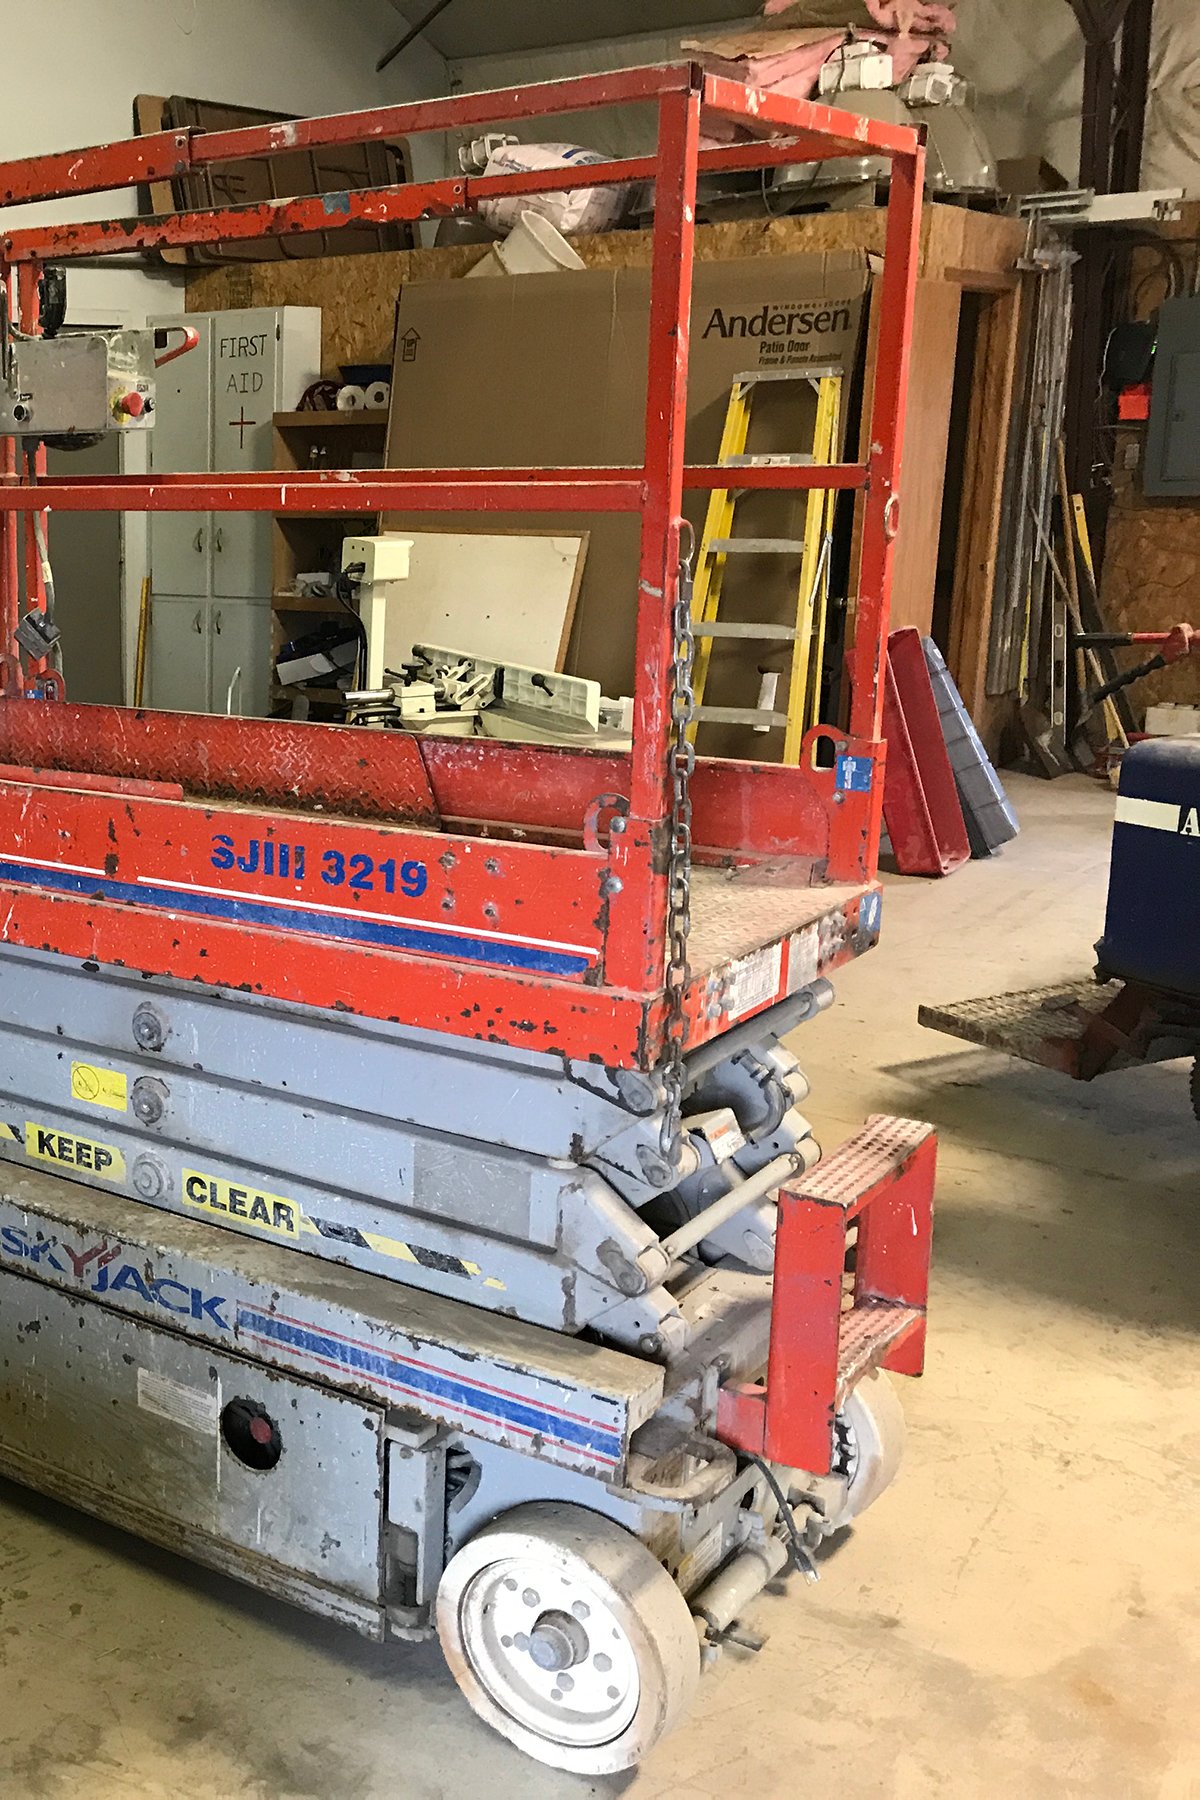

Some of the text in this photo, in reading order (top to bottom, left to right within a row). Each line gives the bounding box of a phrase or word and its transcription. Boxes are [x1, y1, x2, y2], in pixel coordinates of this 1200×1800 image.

[701, 305, 851, 339] Andersen
[220, 334, 267, 358] FIRST
[759, 340, 811, 353] Patio Door
[227, 372, 263, 393] AID
[210, 834, 428, 898] SJIII 3219
[37, 1130, 113, 1172] KEEP
[185, 1176, 295, 1232] CLEAR
[1, 1224, 232, 1331] SKYJACK
